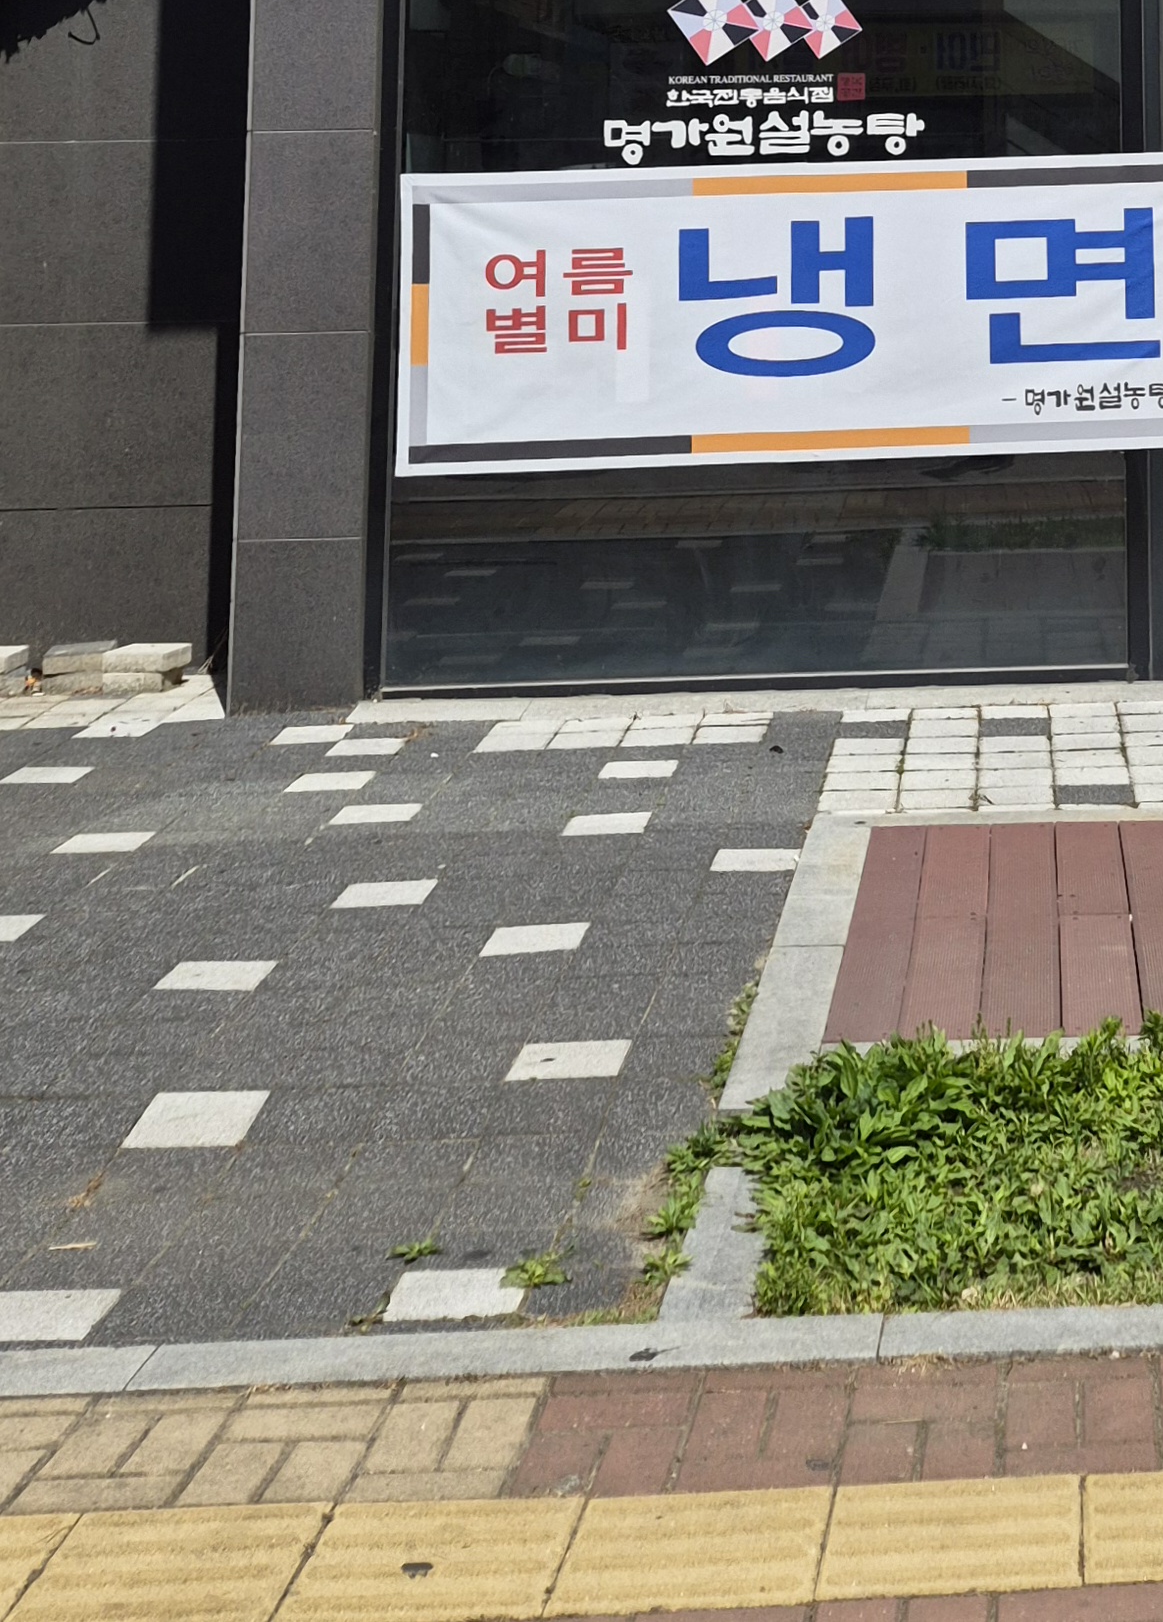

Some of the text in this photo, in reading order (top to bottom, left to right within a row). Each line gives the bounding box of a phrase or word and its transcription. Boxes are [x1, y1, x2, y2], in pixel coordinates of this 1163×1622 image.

[666, 86, 835, 108] 한국전통음식점
[668, 74, 835, 85] KOREAN TRADITIONAL RESTAURANT
[603, 110, 925, 166] 명가원설농탕
[484, 246, 634, 298] 여름
[484, 303, 628, 356] 별미
